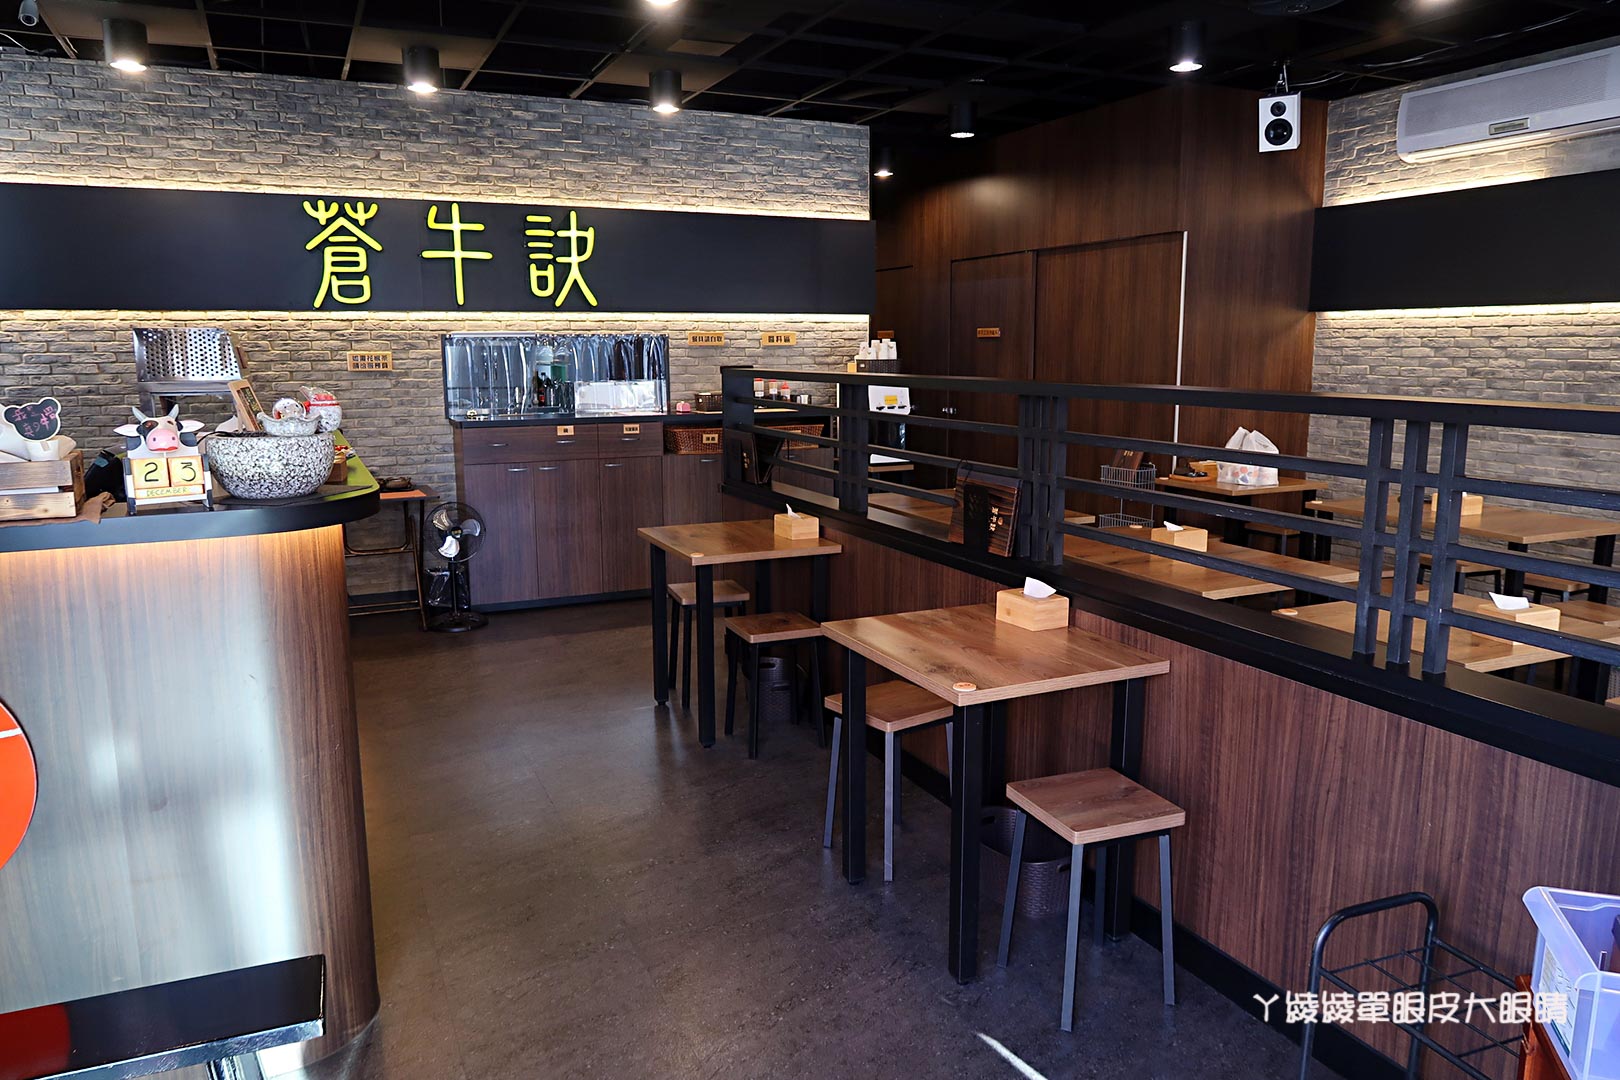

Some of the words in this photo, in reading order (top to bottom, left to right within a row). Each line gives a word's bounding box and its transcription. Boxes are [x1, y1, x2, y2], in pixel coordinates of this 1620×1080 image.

[302, 199, 598, 307] 蒼牛訣
[144, 462, 159, 482] 2
[181, 462, 196, 482] 3
[146, 487, 187, 497] DECEMBER
